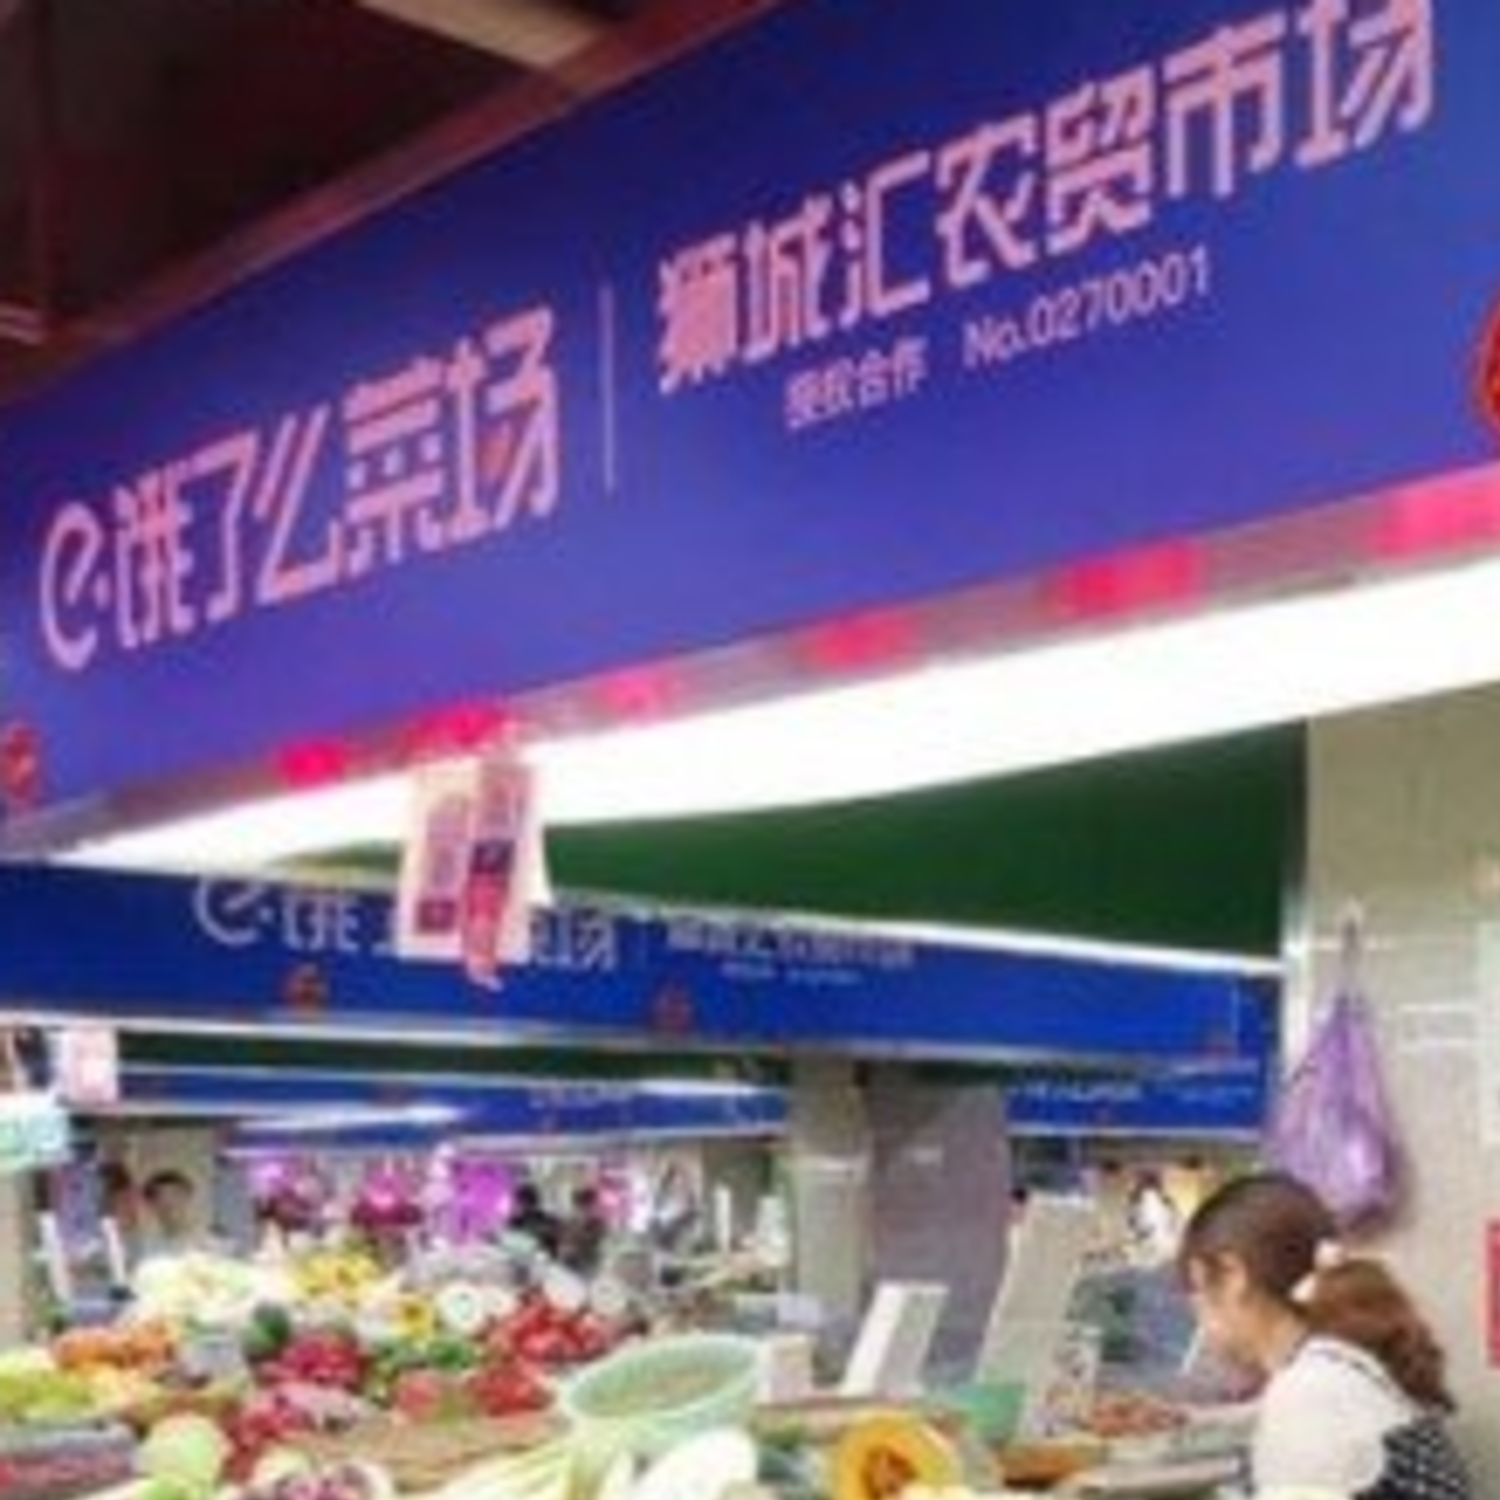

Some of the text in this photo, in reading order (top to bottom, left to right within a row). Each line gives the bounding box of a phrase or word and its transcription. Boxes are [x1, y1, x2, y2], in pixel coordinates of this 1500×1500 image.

[656, 0, 1433, 393] 狮城汇农贸市场
[962, 245, 1208, 368] No.0270001
